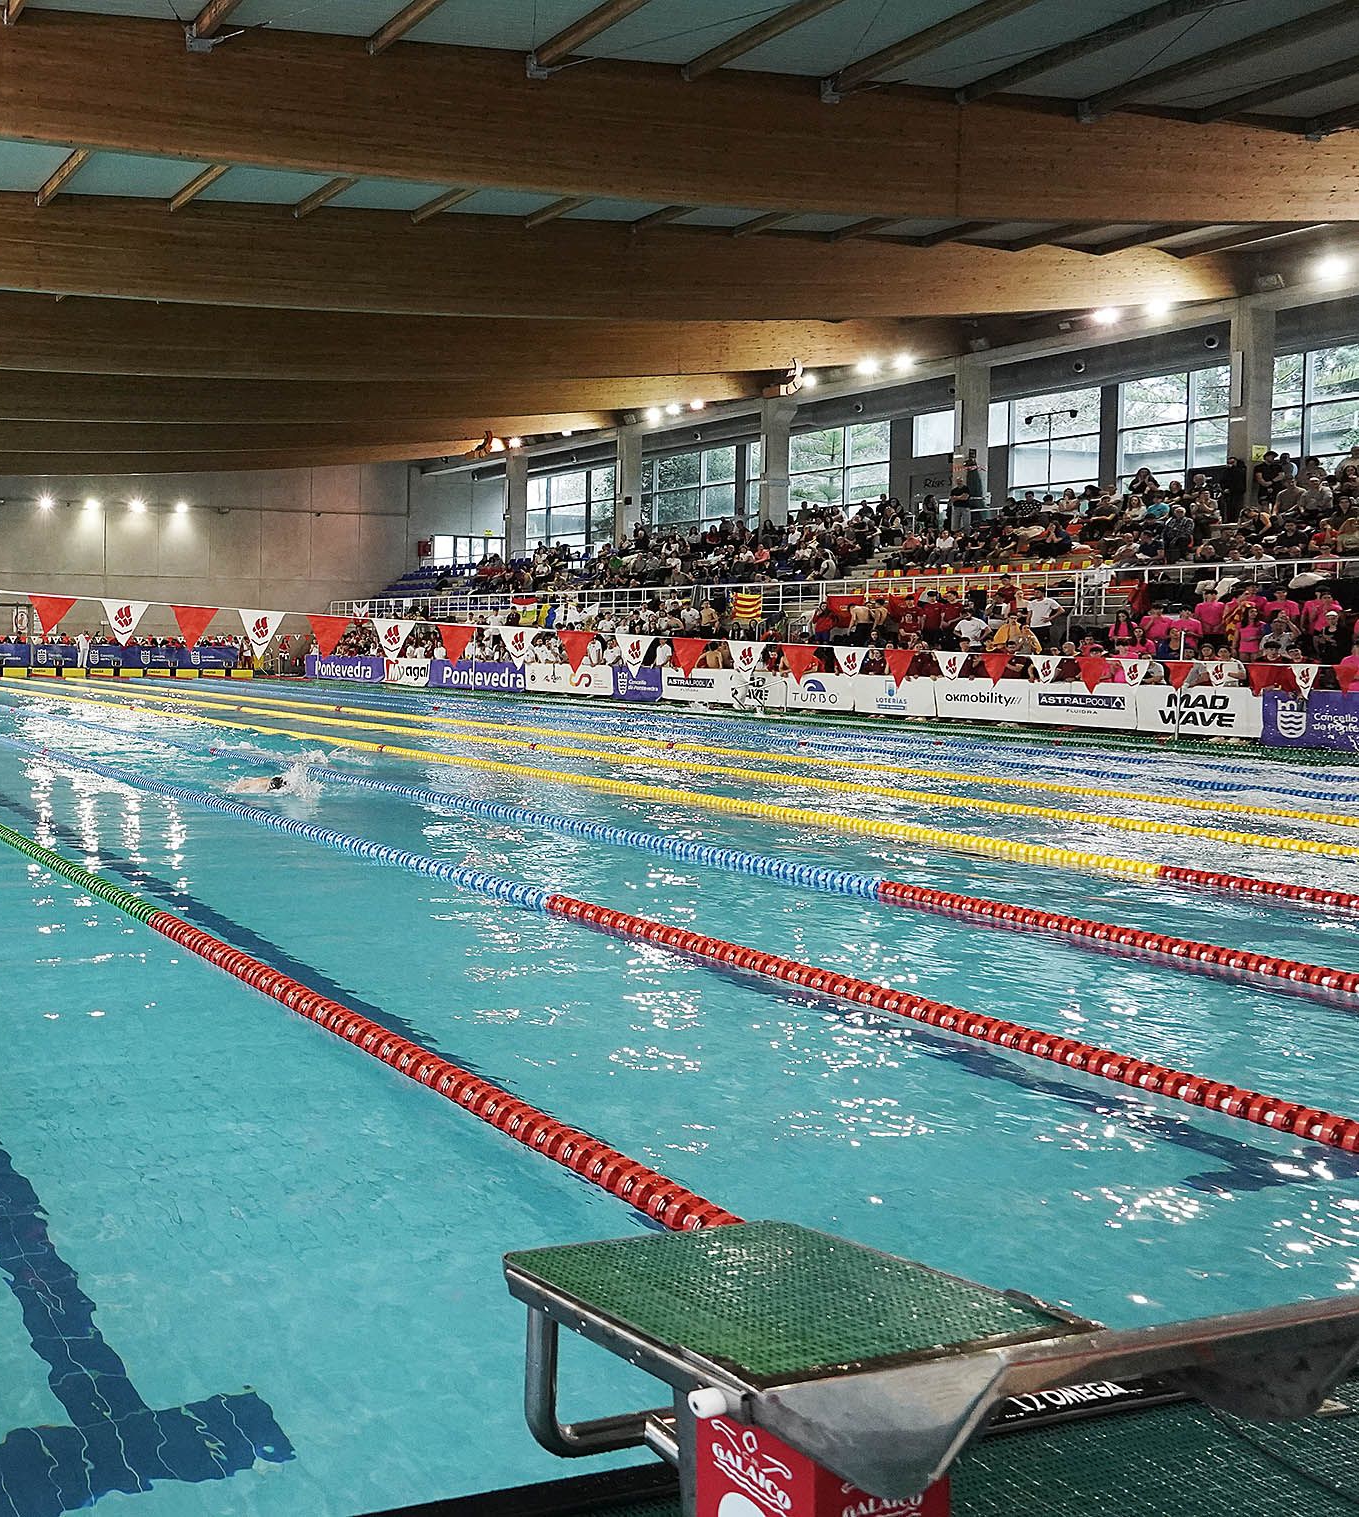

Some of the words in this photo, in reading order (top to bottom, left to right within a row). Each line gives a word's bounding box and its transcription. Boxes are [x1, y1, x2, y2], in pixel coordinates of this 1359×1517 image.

[315, 661, 372, 679] Pontevedra
[442, 666, 525, 688] Pontevedra
[792, 692, 838, 704] TURBO
[1040, 695, 1109, 708] ASTRALPOOL
[1166, 693, 1230, 709] MAD
[1158, 710, 1236, 728] WAVE
[1313, 712, 1359, 723] Concello
[1040, 1380, 1129, 1408] OMEGA
[711, 1442, 792, 1510] GALAICO
